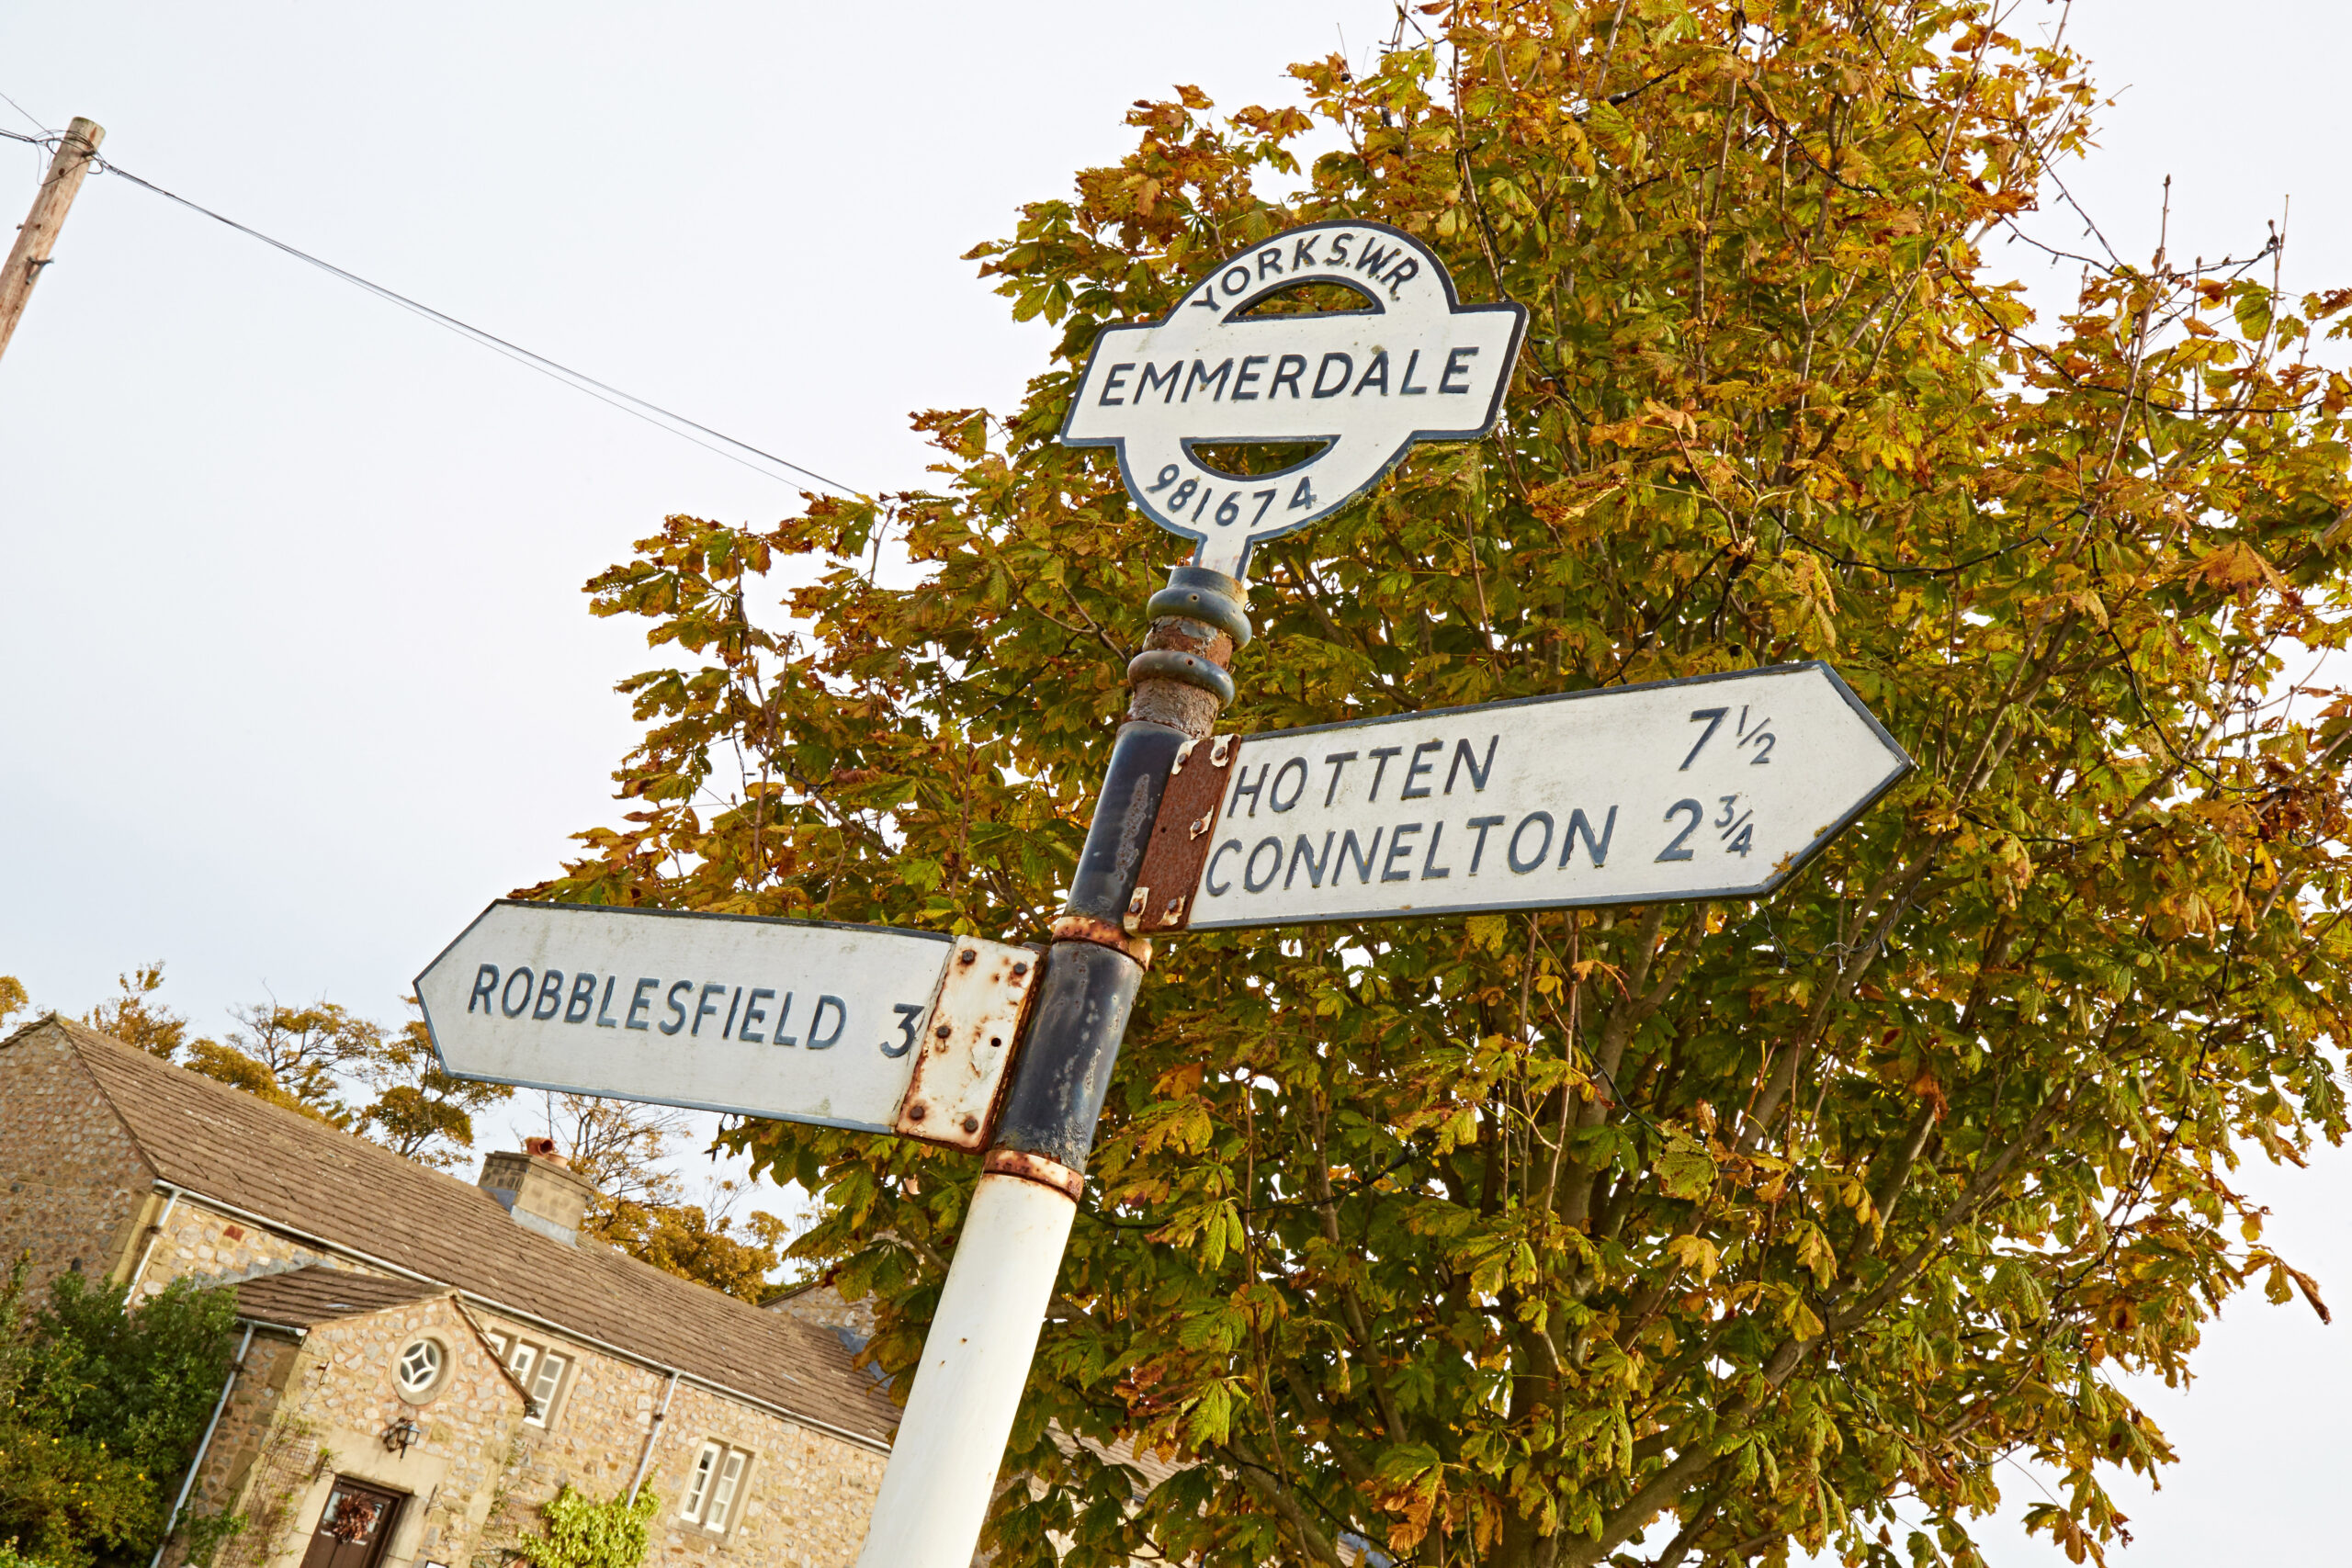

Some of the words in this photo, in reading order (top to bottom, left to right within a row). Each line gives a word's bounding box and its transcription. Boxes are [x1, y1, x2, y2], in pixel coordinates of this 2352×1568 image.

[1099, 345, 1479, 406] EMMERDALE
[1147, 463, 1317, 527] 981674
[1227, 735, 1499, 818] HOTTEN
[1205, 805, 1618, 898] CONNELTON
[469, 963, 847, 1050] ROBBLESFIELD
[879, 1002, 925, 1058] 3
